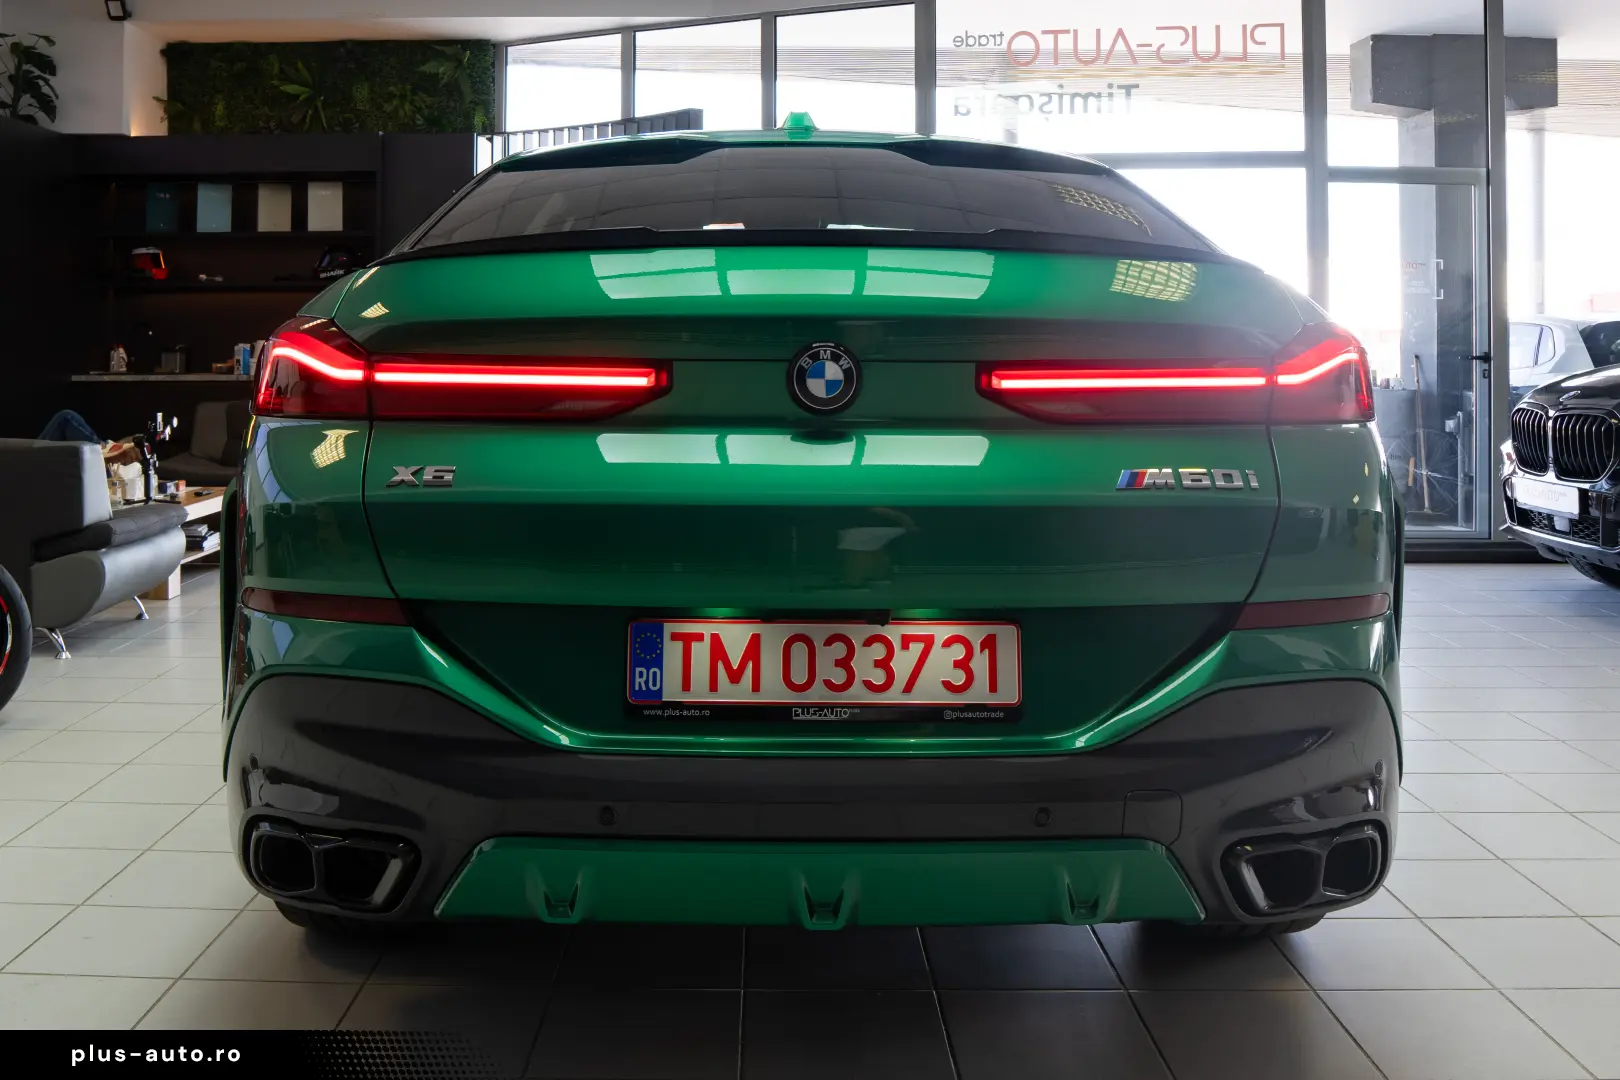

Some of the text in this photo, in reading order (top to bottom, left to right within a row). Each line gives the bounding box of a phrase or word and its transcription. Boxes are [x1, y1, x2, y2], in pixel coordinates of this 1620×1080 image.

[800, 350, 851, 370] BMW
[385, 465, 456, 487] X6
[670, 632, 998, 694] TM 033731
[635, 668, 661, 692] RO
[643, 708, 710, 717] www.plus-auto.ro
[792, 707, 850, 719] PLUS-AUTO
